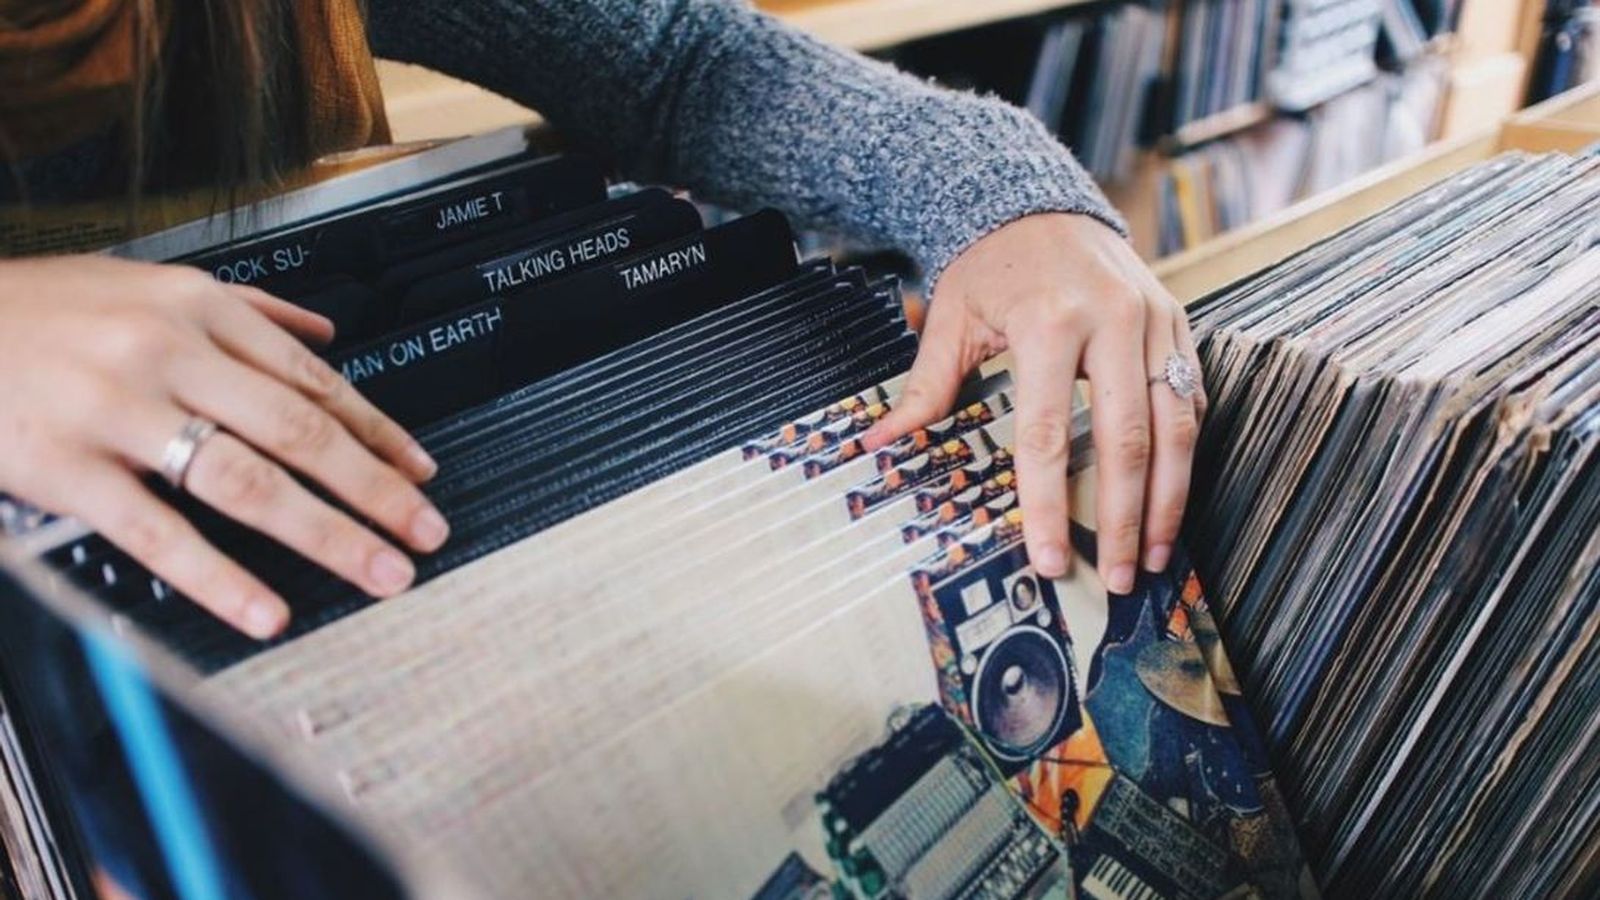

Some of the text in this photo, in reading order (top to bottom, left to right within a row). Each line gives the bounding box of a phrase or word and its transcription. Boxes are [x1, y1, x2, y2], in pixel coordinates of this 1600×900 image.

[437, 191, 503, 229] JAMIE T
[214, 244, 309, 284] OCK SU-
[483, 228, 631, 292] TALKING HEADS
[620, 243, 706, 290] TAMARYN
[389, 335, 425, 366] ON
[429, 306, 502, 351] EARTH
